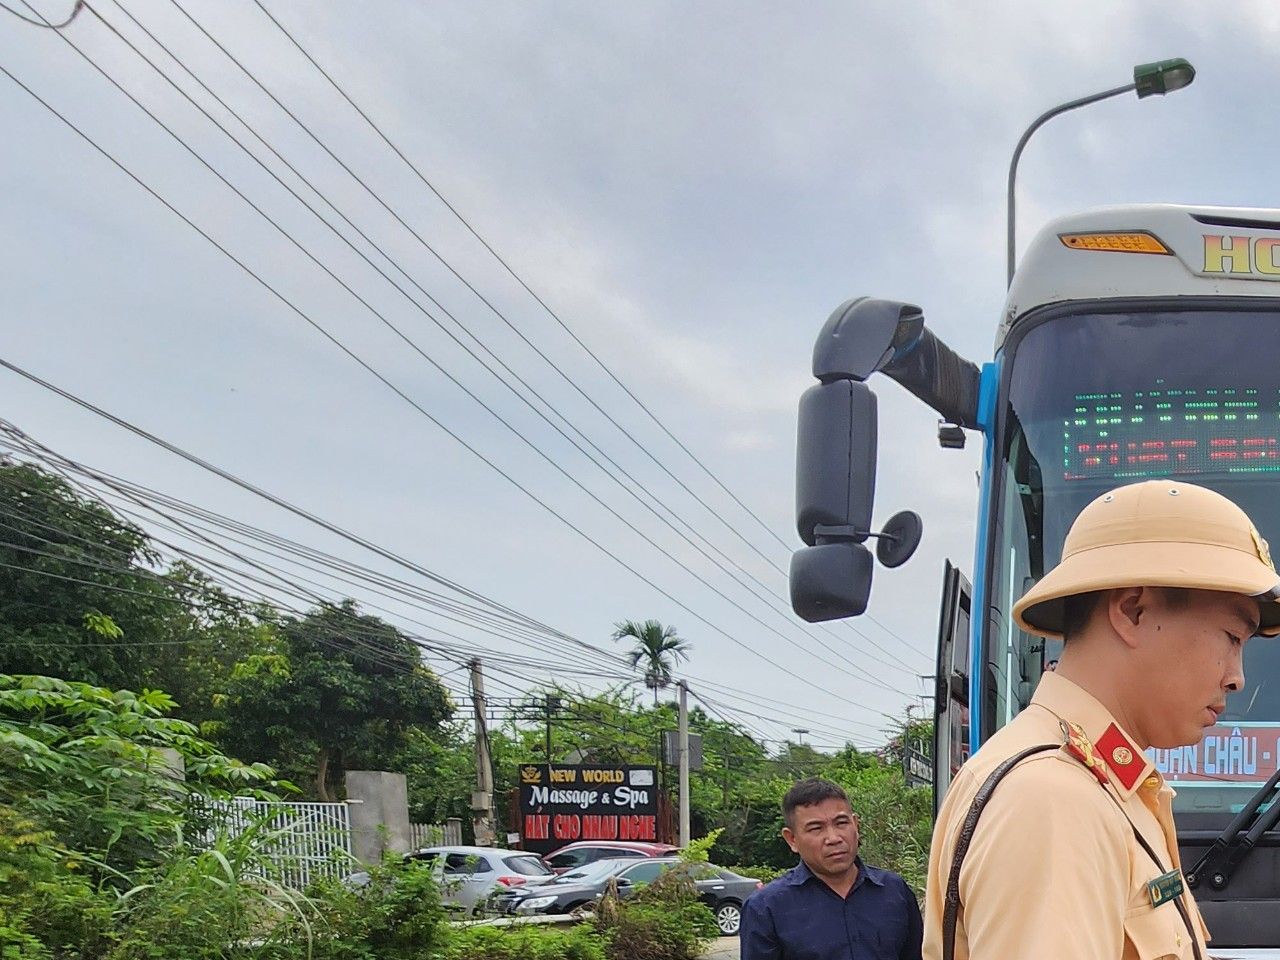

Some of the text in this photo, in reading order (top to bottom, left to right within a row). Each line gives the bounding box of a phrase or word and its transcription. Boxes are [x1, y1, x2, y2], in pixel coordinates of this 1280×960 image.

[1204, 727, 1257, 775] CHÂU
[550, 769, 625, 783] NEW WORLD
[529, 785, 649, 809] Massage & Spa
[525, 805, 656, 839] HÁT CHO NHAU NGHE
